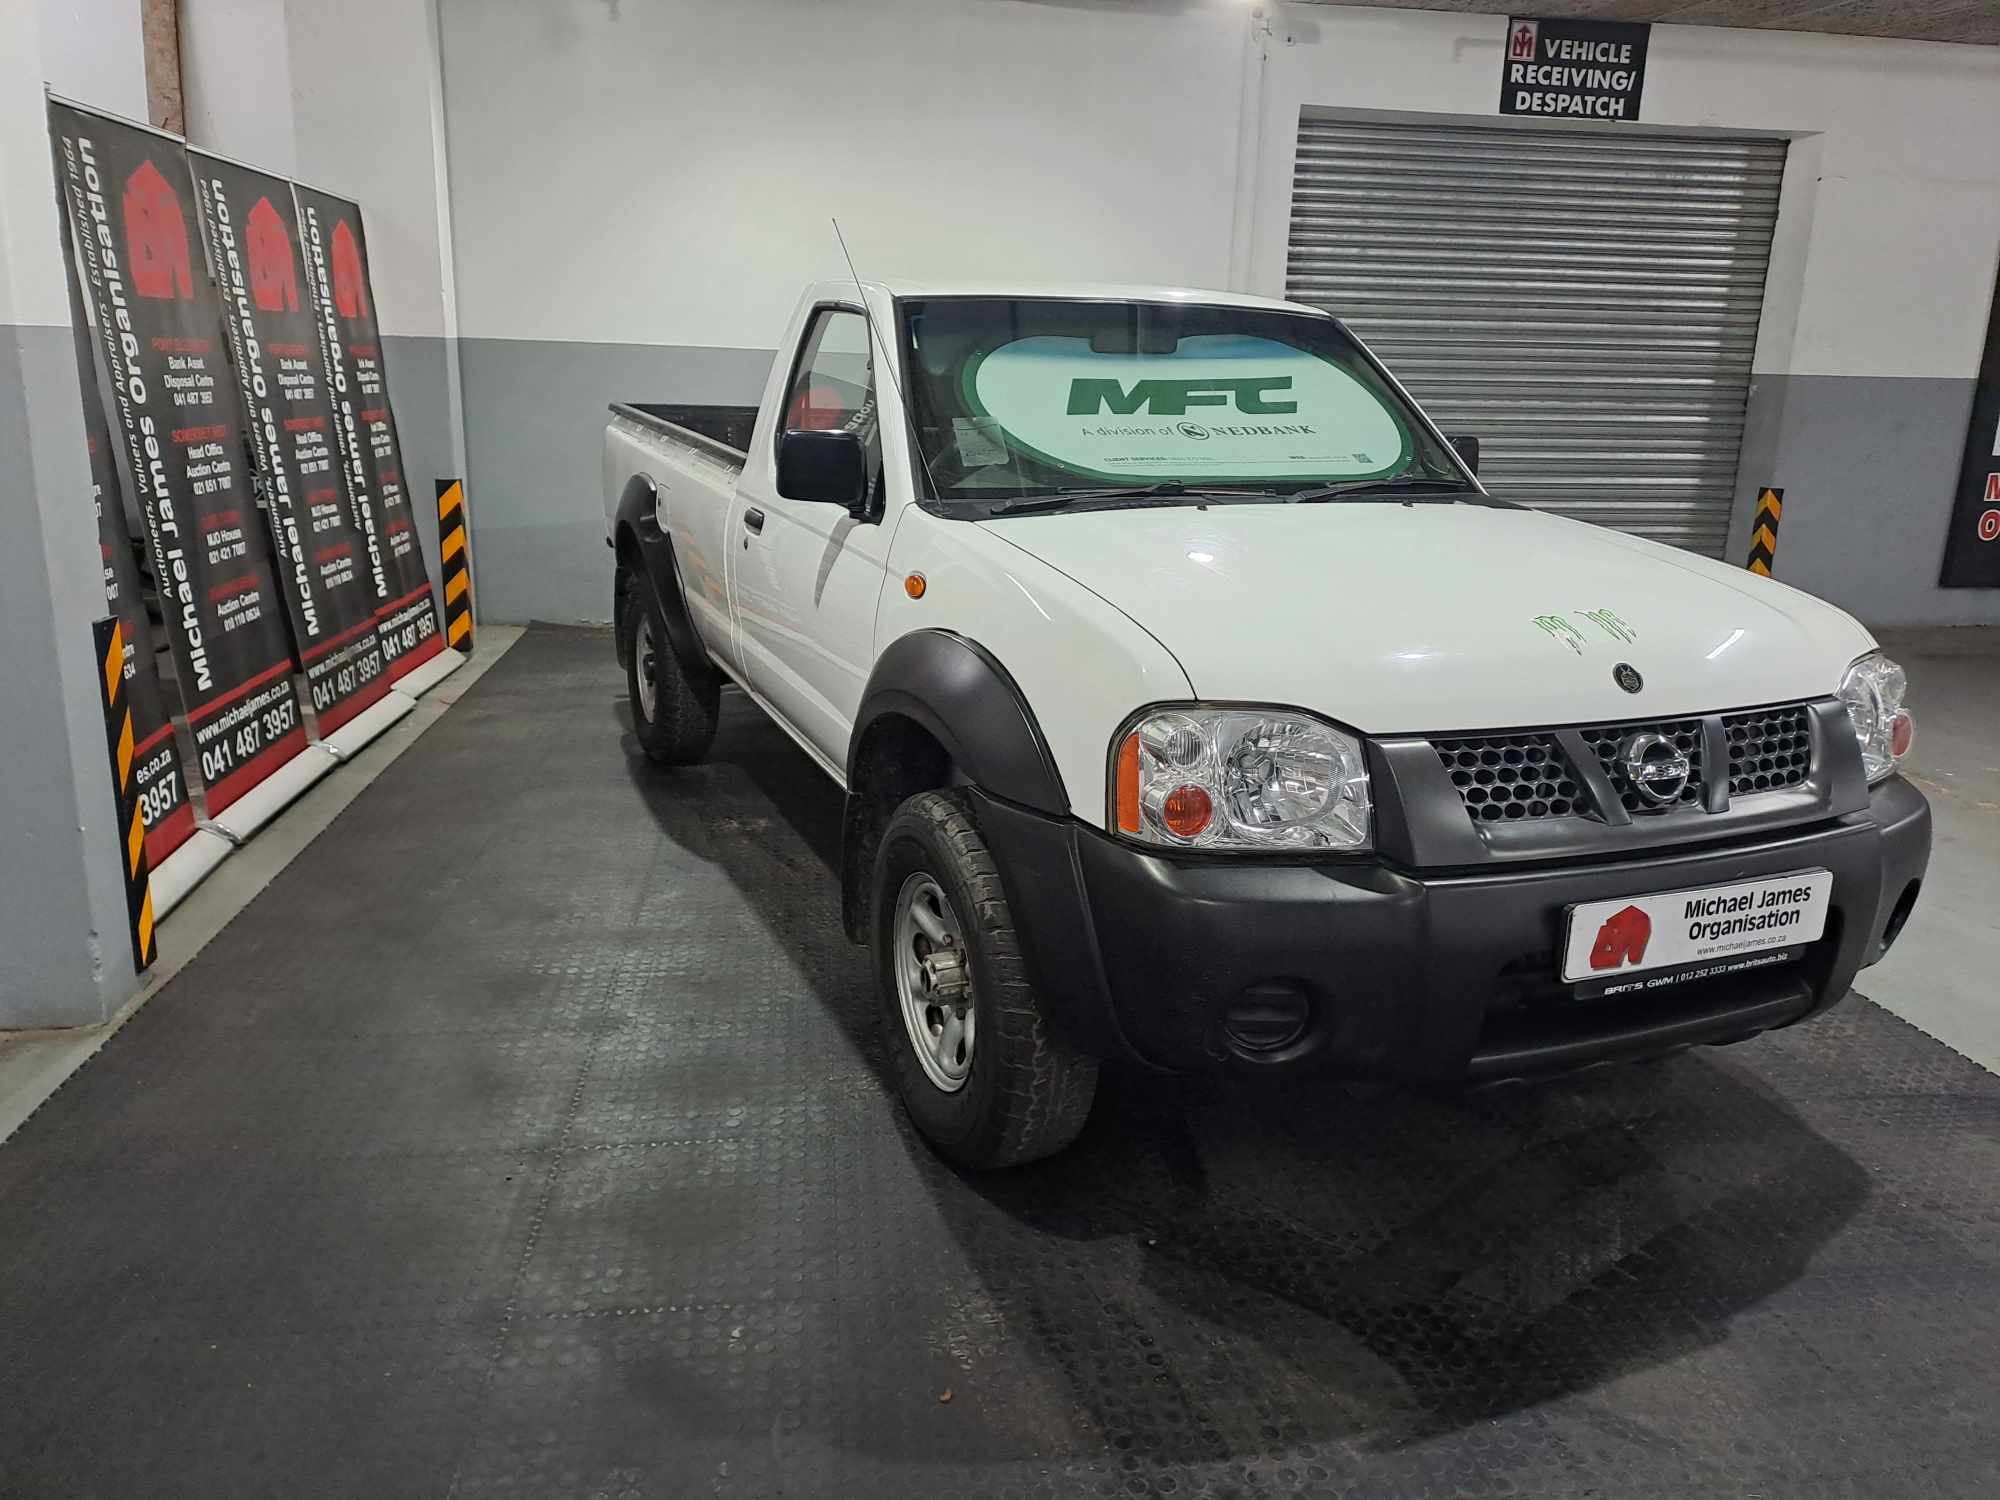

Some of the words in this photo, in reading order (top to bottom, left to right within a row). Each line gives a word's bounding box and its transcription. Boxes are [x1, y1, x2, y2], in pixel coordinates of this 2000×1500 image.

[1510, 64, 1636, 92] RECEIVING/
[1544, 38, 1632, 64] VEHICLE
[1515, 91, 1625, 117] DESPATCH
[61, 135, 79, 181] 1964
[76, 184, 102, 287] Established
[207, 218, 231, 301] Established
[78, 136, 147, 404] Organisation
[211, 178, 266, 398] Organisation
[307, 206, 347, 393] Organisation
[99, 303, 125, 393] Appraisers
[168, 355, 186, 369] Bank
[228, 313, 250, 389] Appraisers
[163, 373, 195, 390] Disposal
[244, 391, 257, 418] and
[1066, 375, 1298, 416] MFC
[118, 395, 133, 429] and
[1097, 426, 1156, 436] division
[1158, 426, 1175, 436] of
[1211, 424, 1317, 436] NEDBANK
[129, 432, 149, 494] Valuers
[186, 463, 212, 479] Auction
[252, 421, 268, 471] Valuers
[261, 407, 292, 509] James
[341, 400, 366, 489] James
[139, 415, 180, 539] James
[145, 500, 173, 598] Auctioneers,
[357, 494, 388, 599] Michael
[283, 518, 320, 637] Michael
[166, 549, 214, 692] Michael
[217, 600, 240, 617] Auction
[381, 633, 402, 661] 041
[402, 624, 417, 649] 487
[416, 612, 436, 640] 3957
[313, 678, 336, 710] 041
[337, 665, 357, 695] 487
[357, 650, 381, 682] 3957
[196, 680, 290, 745] www.michaeljames.co.za
[202, 739, 232, 780] 041
[236, 719, 260, 757] 487
[263, 699, 295, 740] 3957
[139, 770, 178, 826] 3957
[1684, 891, 1755, 919] Michael
[1757, 885, 1812, 911] James
[1688, 908, 1801, 941] Organisation
[1696, 934, 1787, 956] www.michaeljames.co.za
[1647, 975, 1674, 988] GWM
[1680, 971, 1694, 982] 012
[1695, 968, 1709, 979] 252
[1709, 963, 1727, 976] 3333
